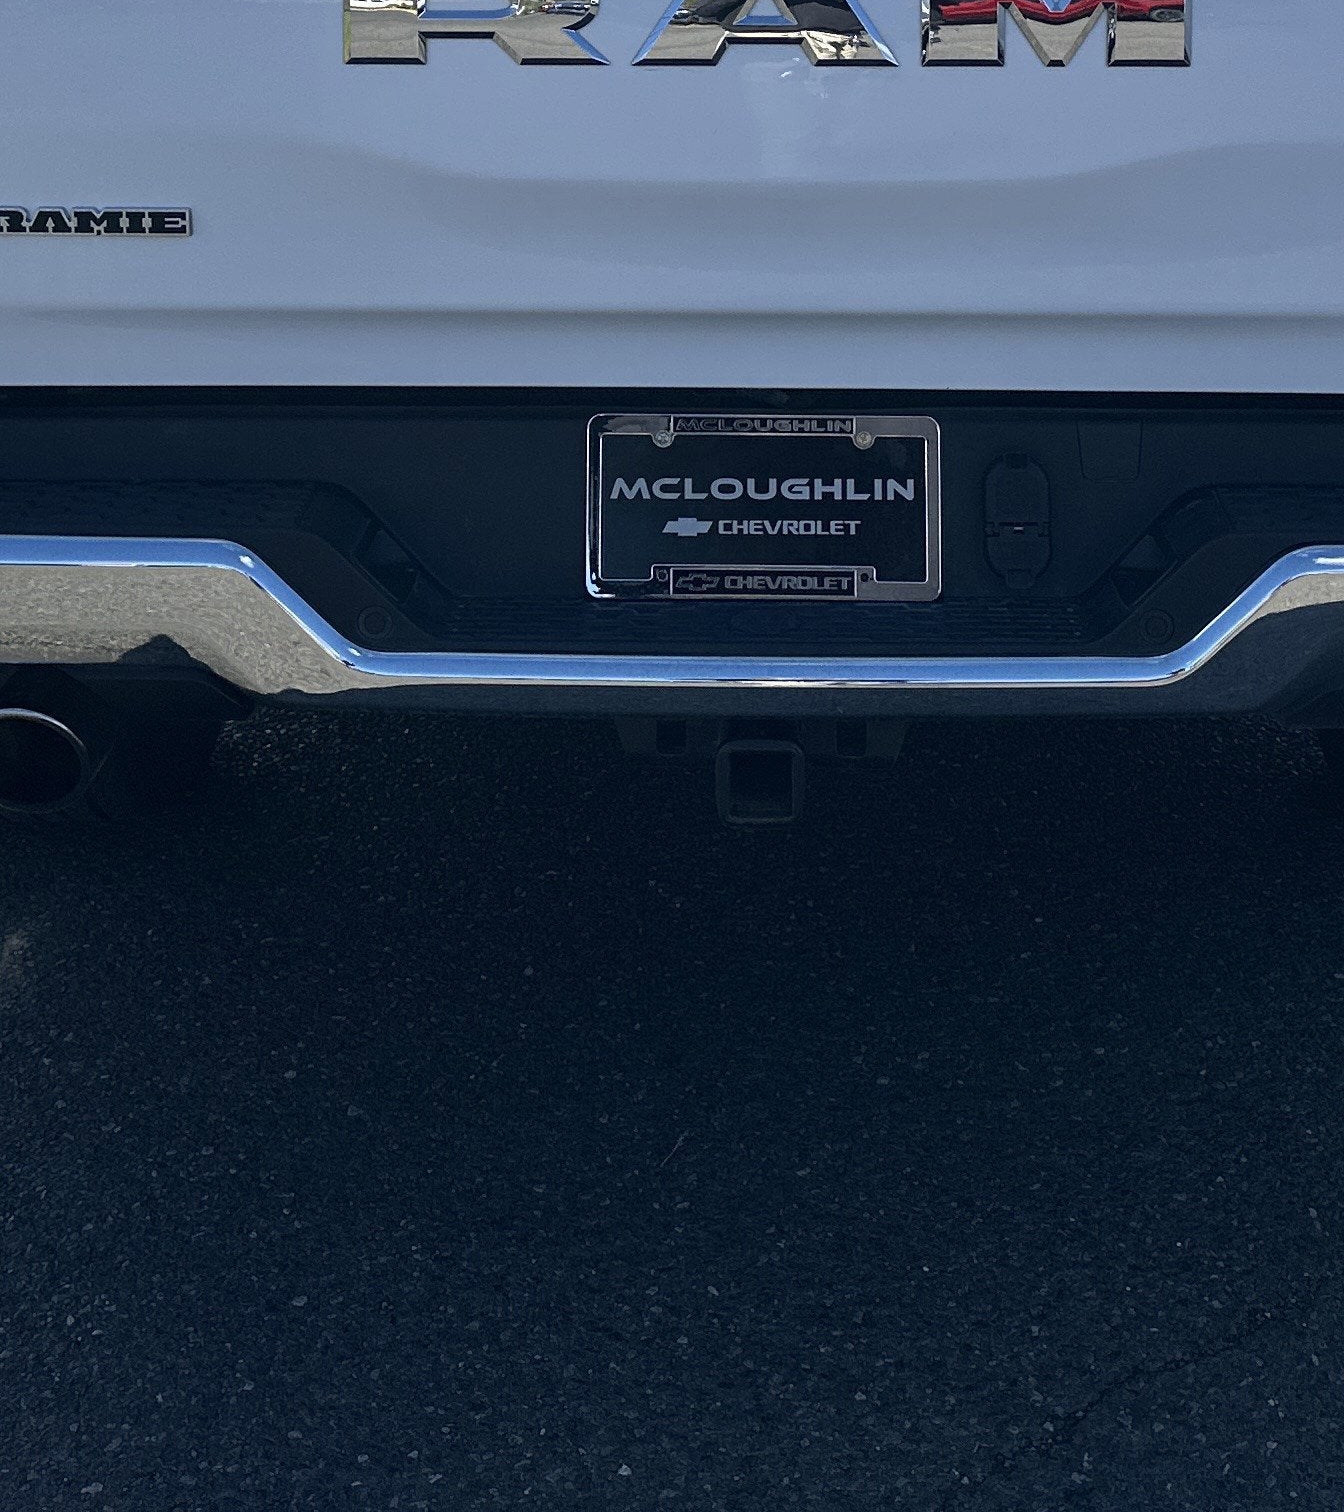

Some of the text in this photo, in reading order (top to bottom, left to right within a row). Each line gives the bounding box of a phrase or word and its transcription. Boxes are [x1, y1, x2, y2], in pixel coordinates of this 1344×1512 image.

[675, 417, 852, 433] MCLOUGHLIN
[609, 477, 915, 501] MCLOUGHLIN
[717, 519, 862, 536] CHEVROLET
[723, 574, 852, 591] CHEVROLET
